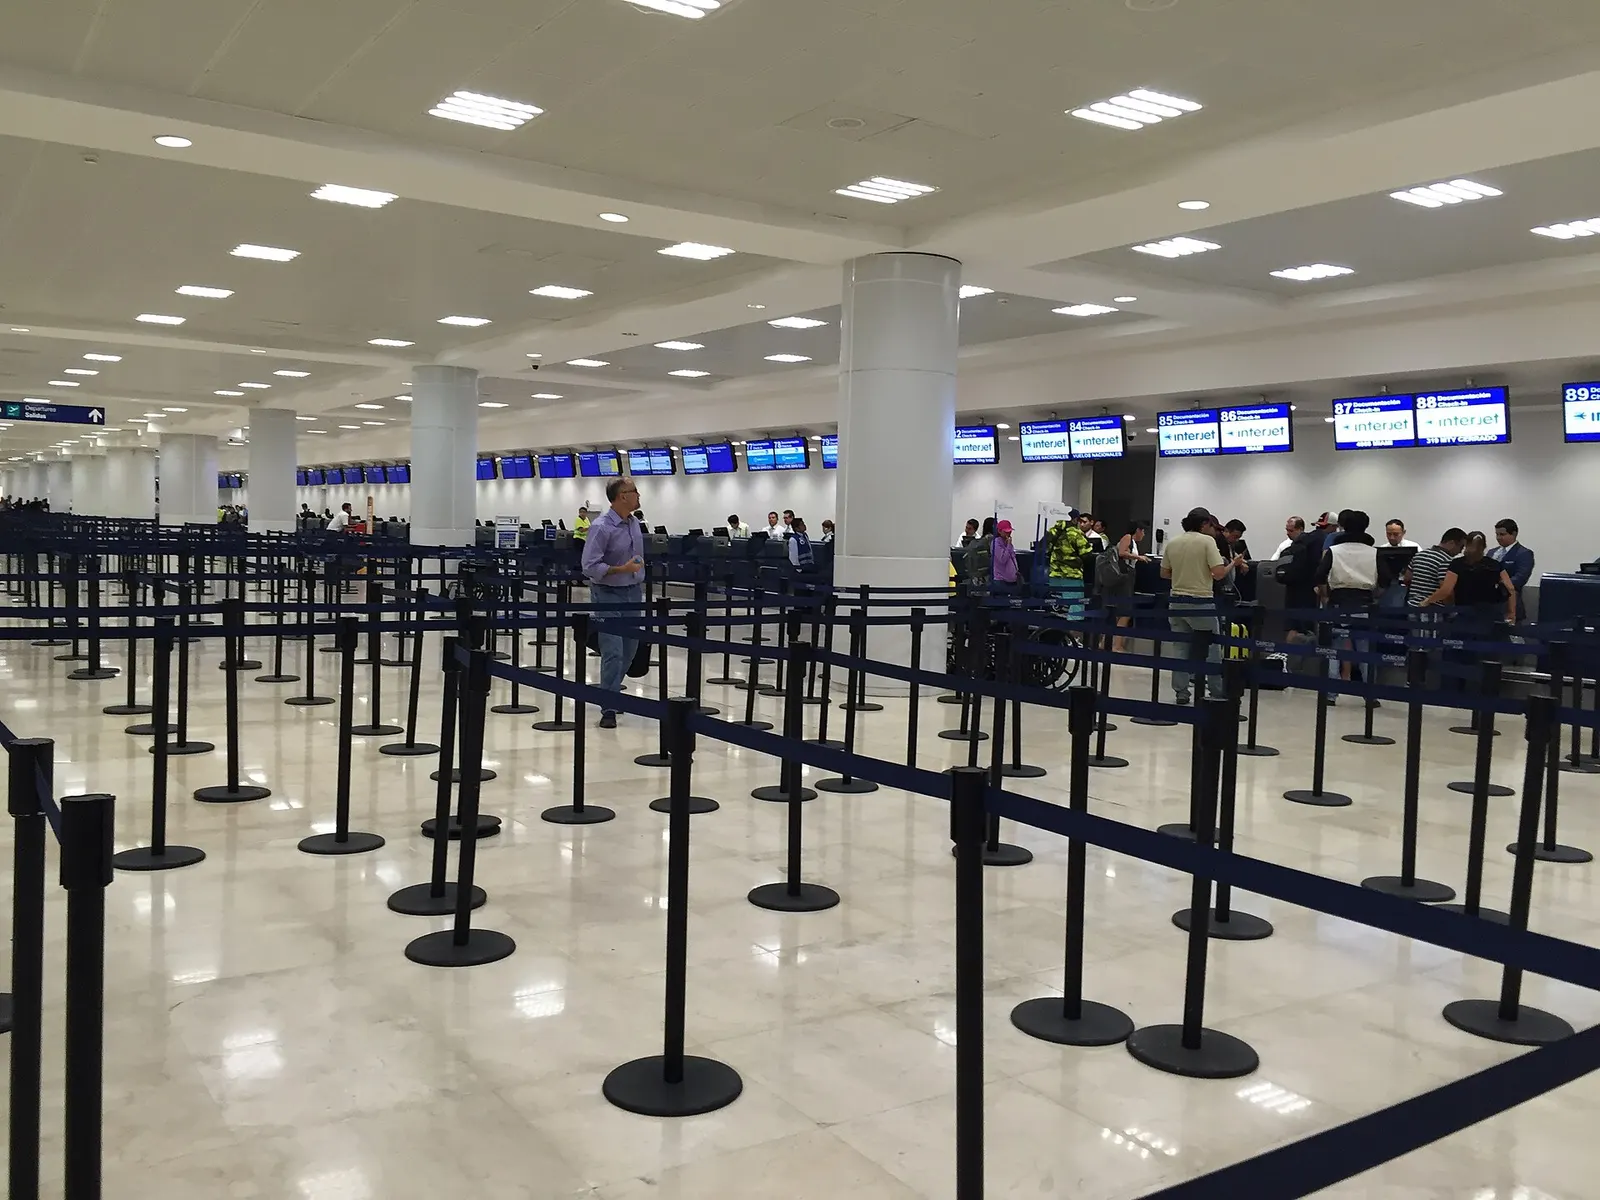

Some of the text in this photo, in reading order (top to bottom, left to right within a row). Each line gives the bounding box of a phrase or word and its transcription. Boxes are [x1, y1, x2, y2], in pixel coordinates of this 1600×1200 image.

[1566, 388, 1589, 401] 89
[1417, 396, 1437, 408] 88
[25, 404, 56, 412] Departures
[1334, 403, 1352, 414] 87
[1159, 416, 1172, 425] 85
[1221, 411, 1237, 421] 86
[1439, 413, 1498, 426] interjet
[1021, 426, 1032, 434] 83
[1070, 422, 1081, 431] 84
[1355, 420, 1408, 431] interjet
[1174, 430, 1215, 441] interjet
[1238, 426, 1284, 437] interjet
[1033, 439, 1066, 448] interjet
[1083, 436, 1119, 445] interjet
[962, 443, 992, 451] interjet
